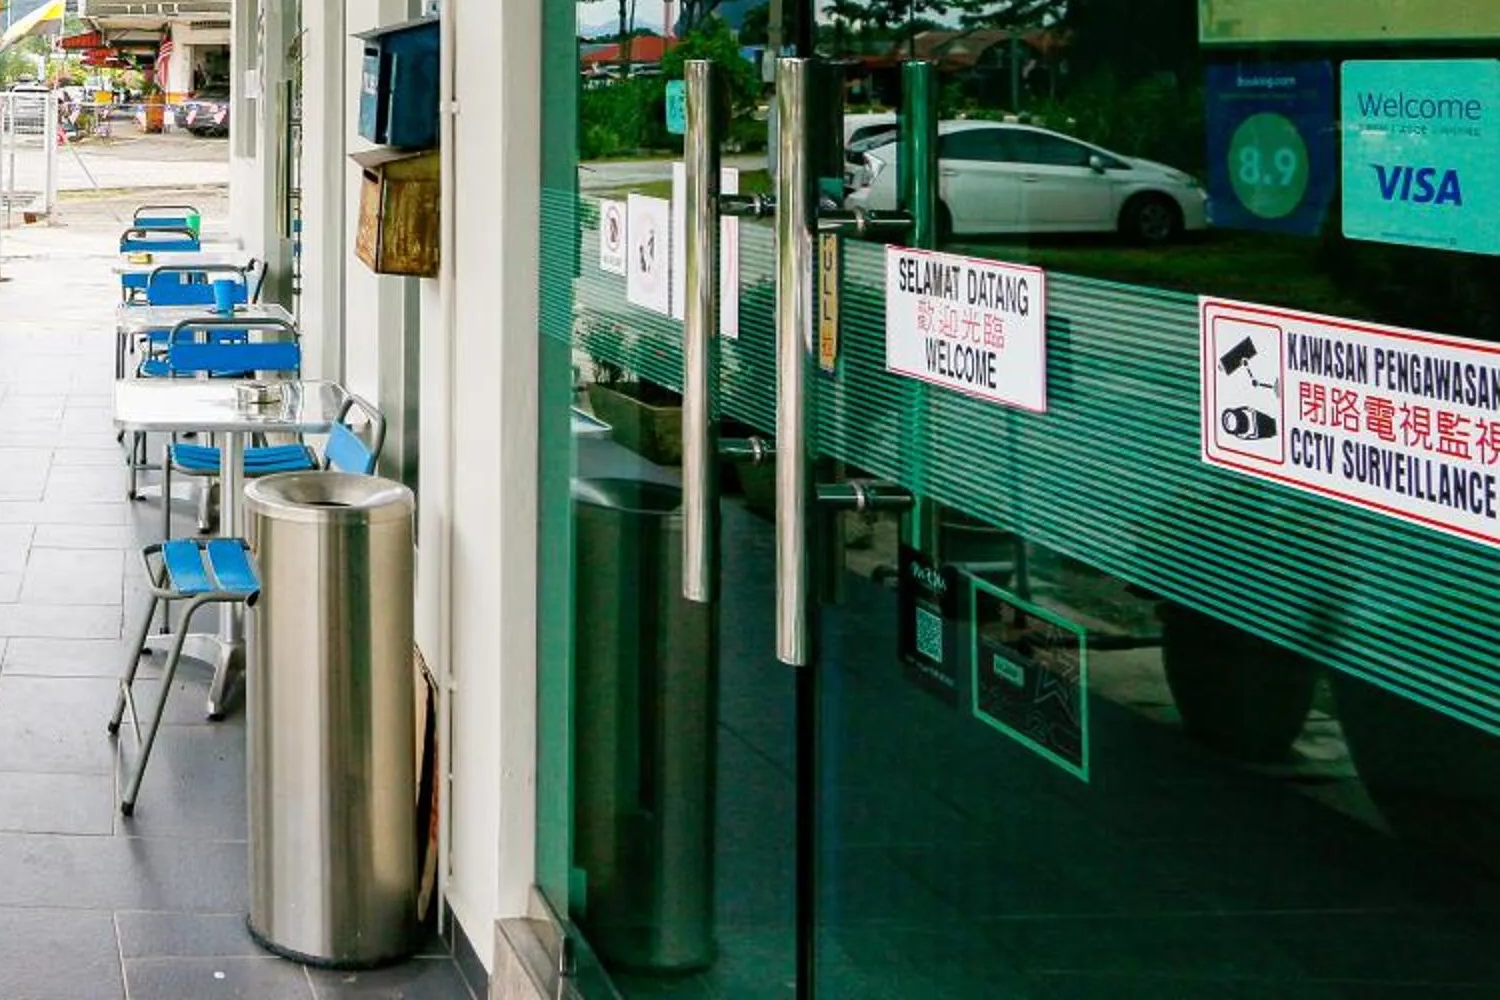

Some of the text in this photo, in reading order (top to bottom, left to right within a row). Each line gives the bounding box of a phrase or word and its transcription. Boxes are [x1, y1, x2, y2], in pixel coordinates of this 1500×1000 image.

[1357, 91, 1481, 121] Welcome
[1240, 146, 1296, 186] 8.9
[1371, 163, 1463, 207] VISA
[899, 257, 1030, 317] SELAMAT DATANG
[925, 337, 997, 389] WELCOME
[1287, 332, 1368, 384] KAWASAN
[1290, 427, 1497, 518] CCTV SURVEILLANCE
